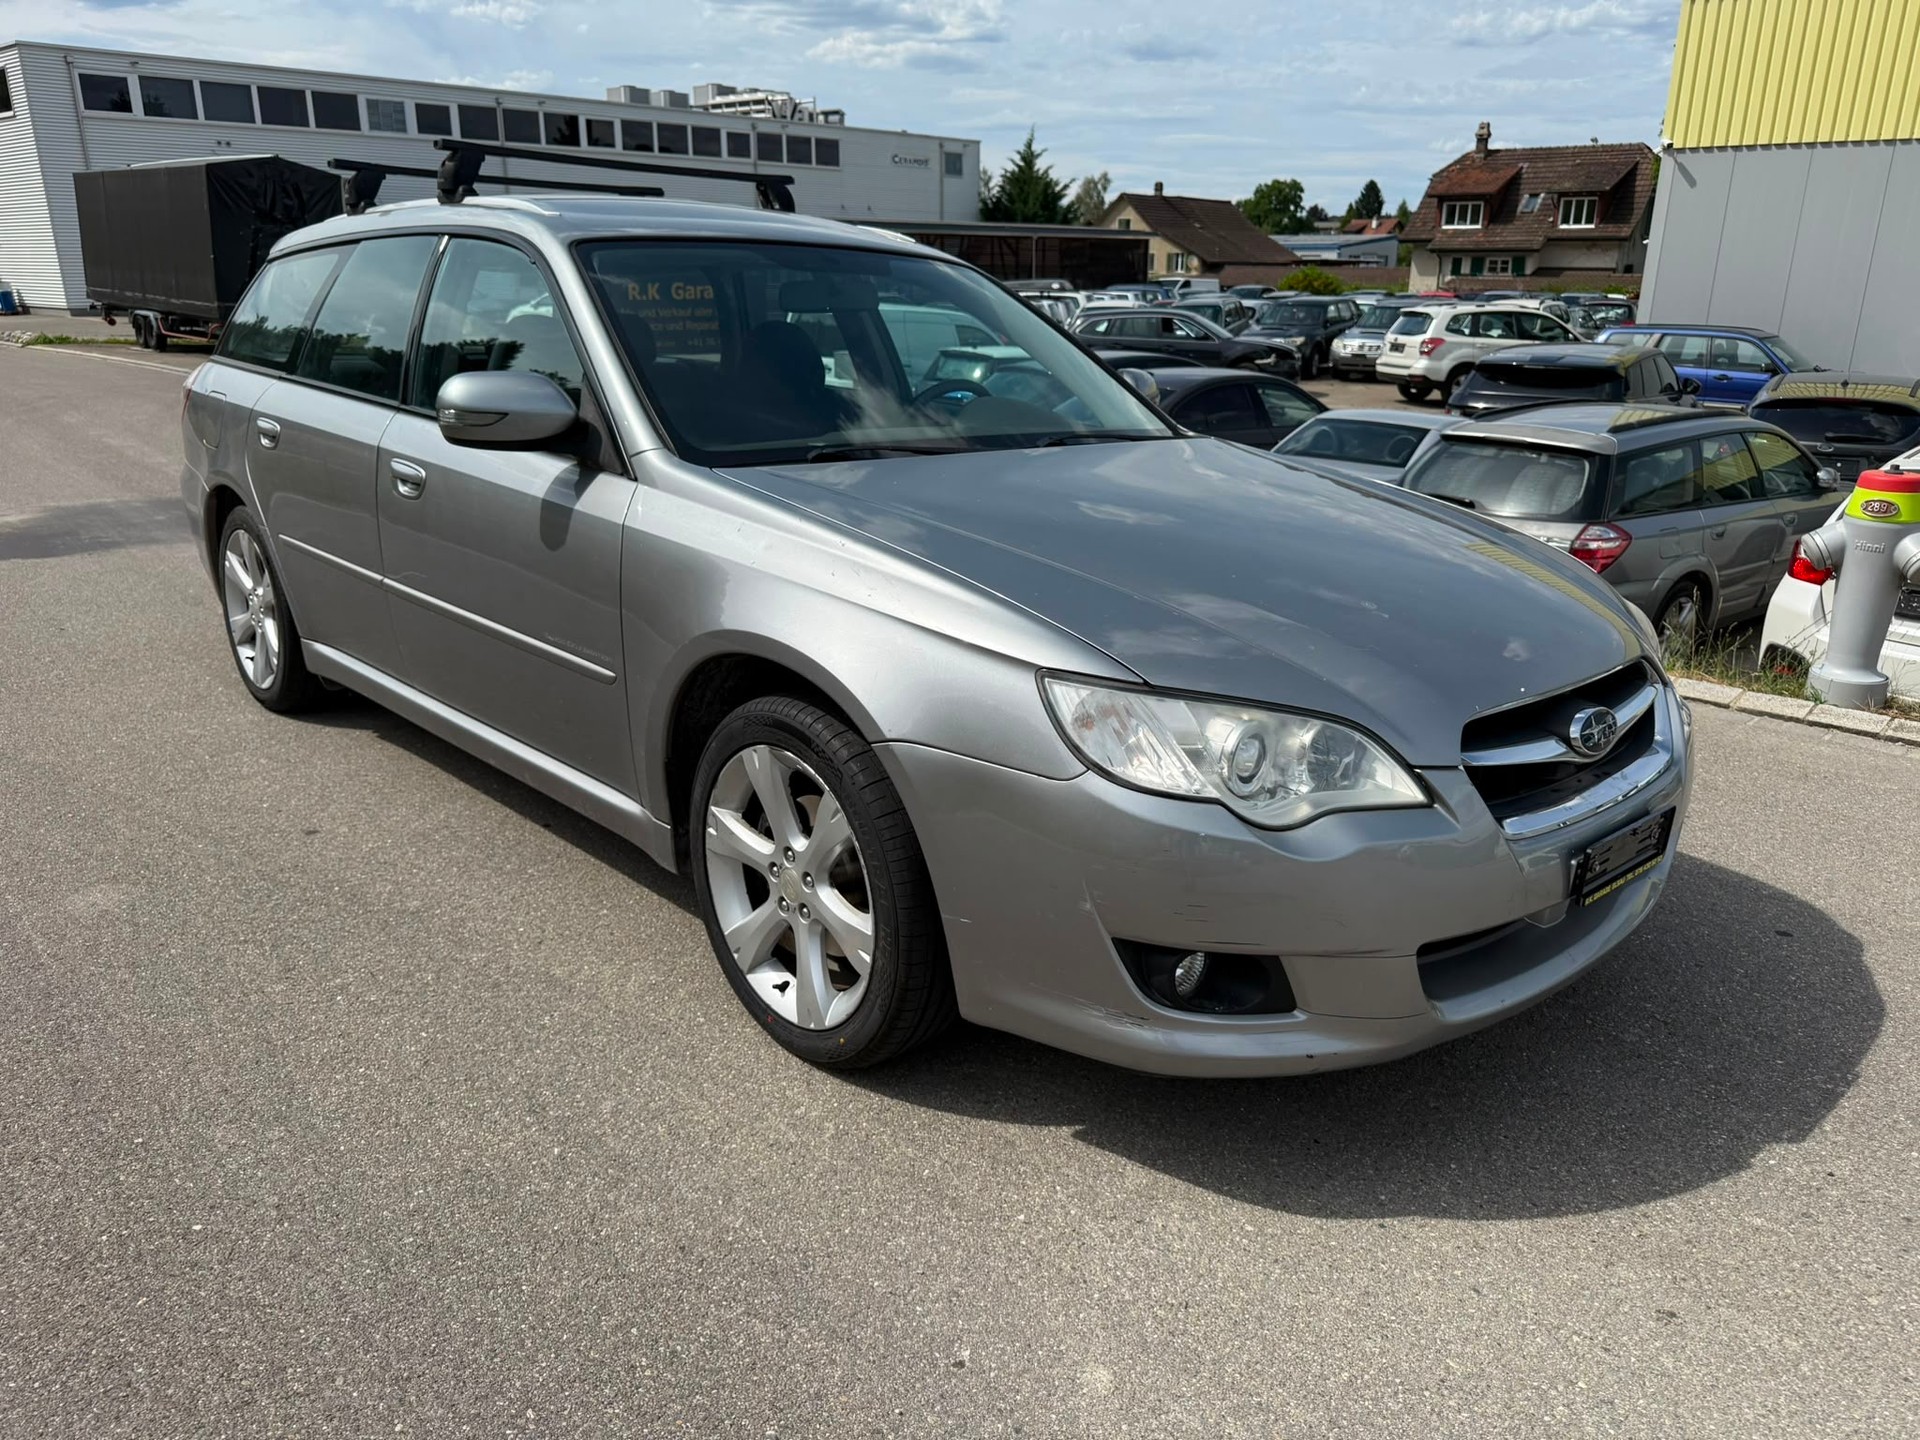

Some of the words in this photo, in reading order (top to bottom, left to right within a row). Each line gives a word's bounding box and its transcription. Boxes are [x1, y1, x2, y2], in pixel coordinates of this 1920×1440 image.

[627, 283, 660, 300] R.K
[1867, 501, 1888, 512] 289
[1855, 540, 1886, 554] Hinni
